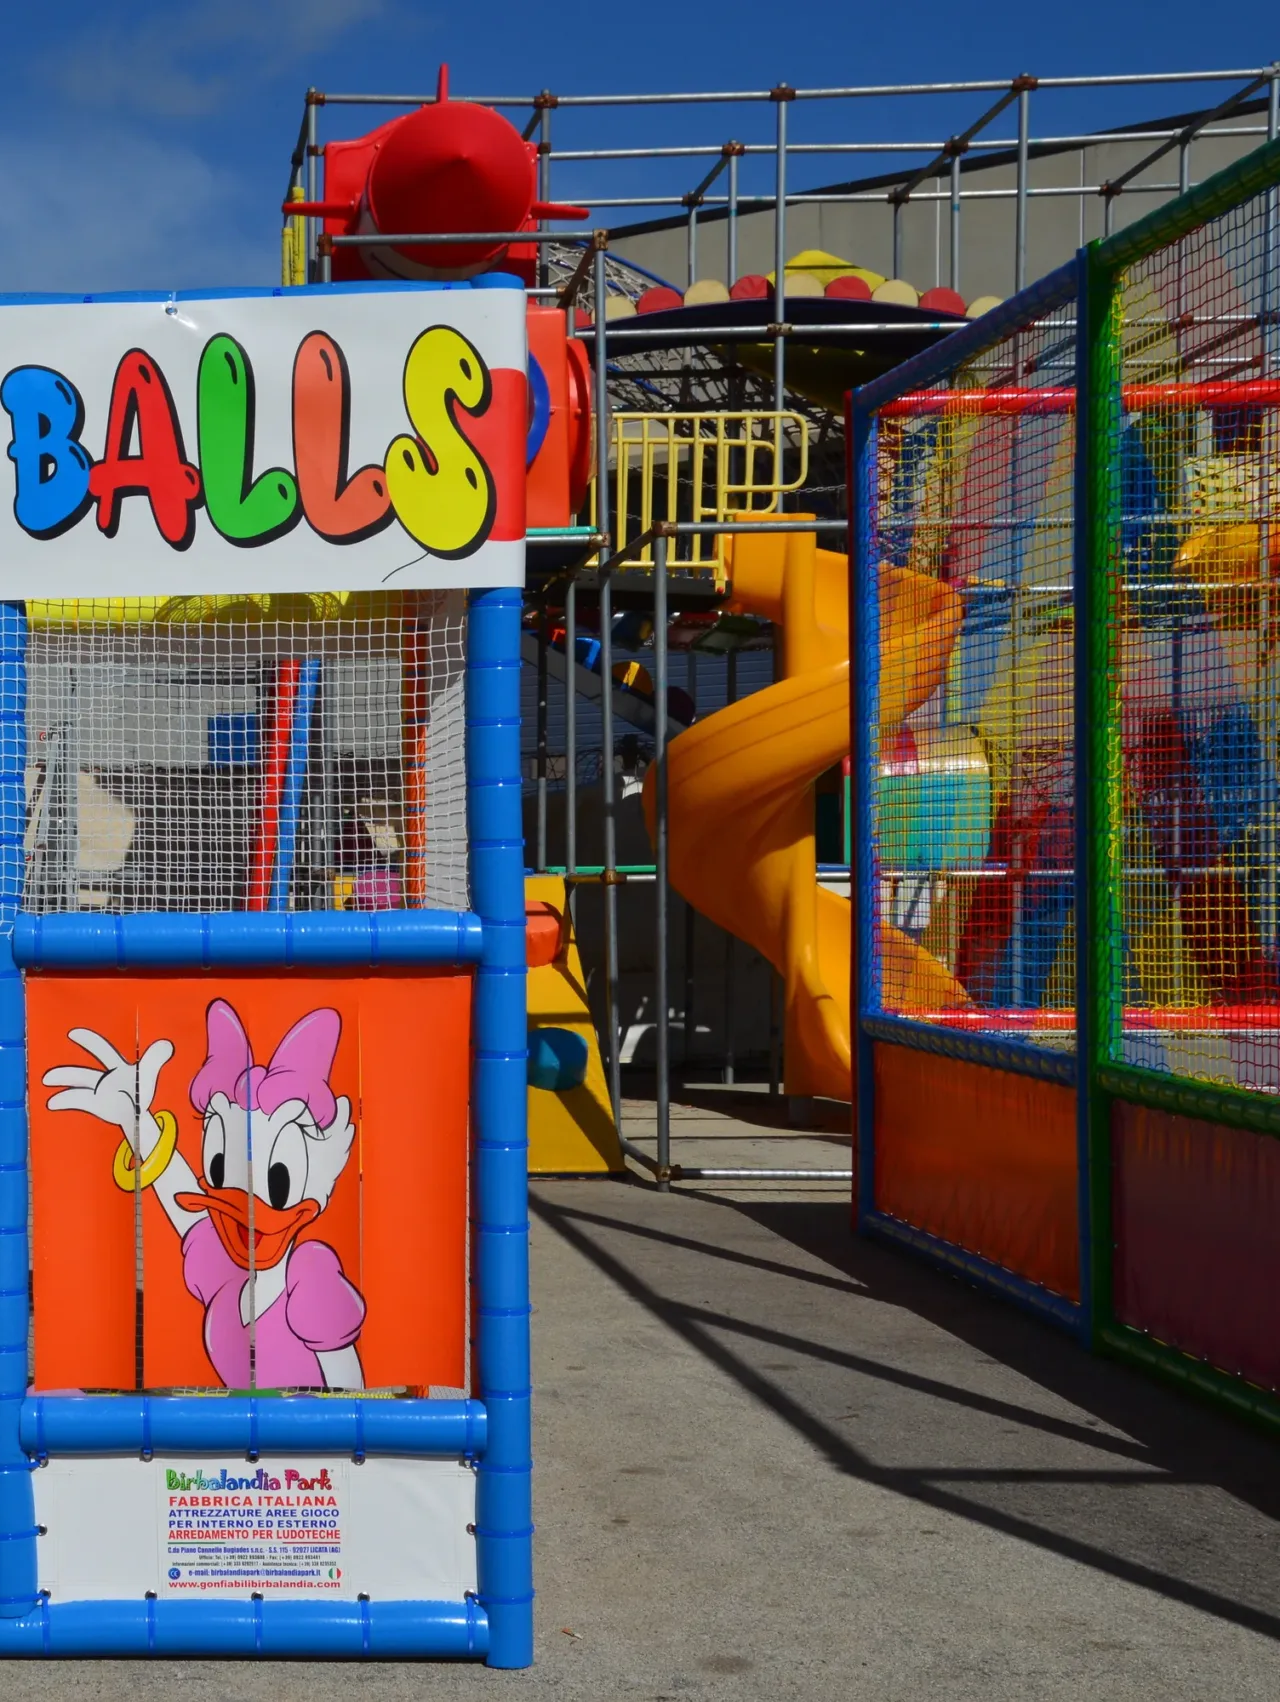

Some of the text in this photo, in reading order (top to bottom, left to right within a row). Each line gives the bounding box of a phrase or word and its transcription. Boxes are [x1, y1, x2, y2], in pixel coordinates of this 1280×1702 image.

[0, 323, 495, 560] BALLS
[166, 1468, 332, 1491] Birbalandia Park
[169, 1496, 337, 1506] FABBRICA ITALIANA
[169, 1509, 339, 1517] ATTREZZATURE AREE GIOCO
[169, 1520, 336, 1528] PER INTERNO ED ESTERNO
[169, 1530, 340, 1539] ARREDAMENTO PER LUDOTECHE
[169, 1580, 341, 1589] www.gonfiabilibirbalandia.com
